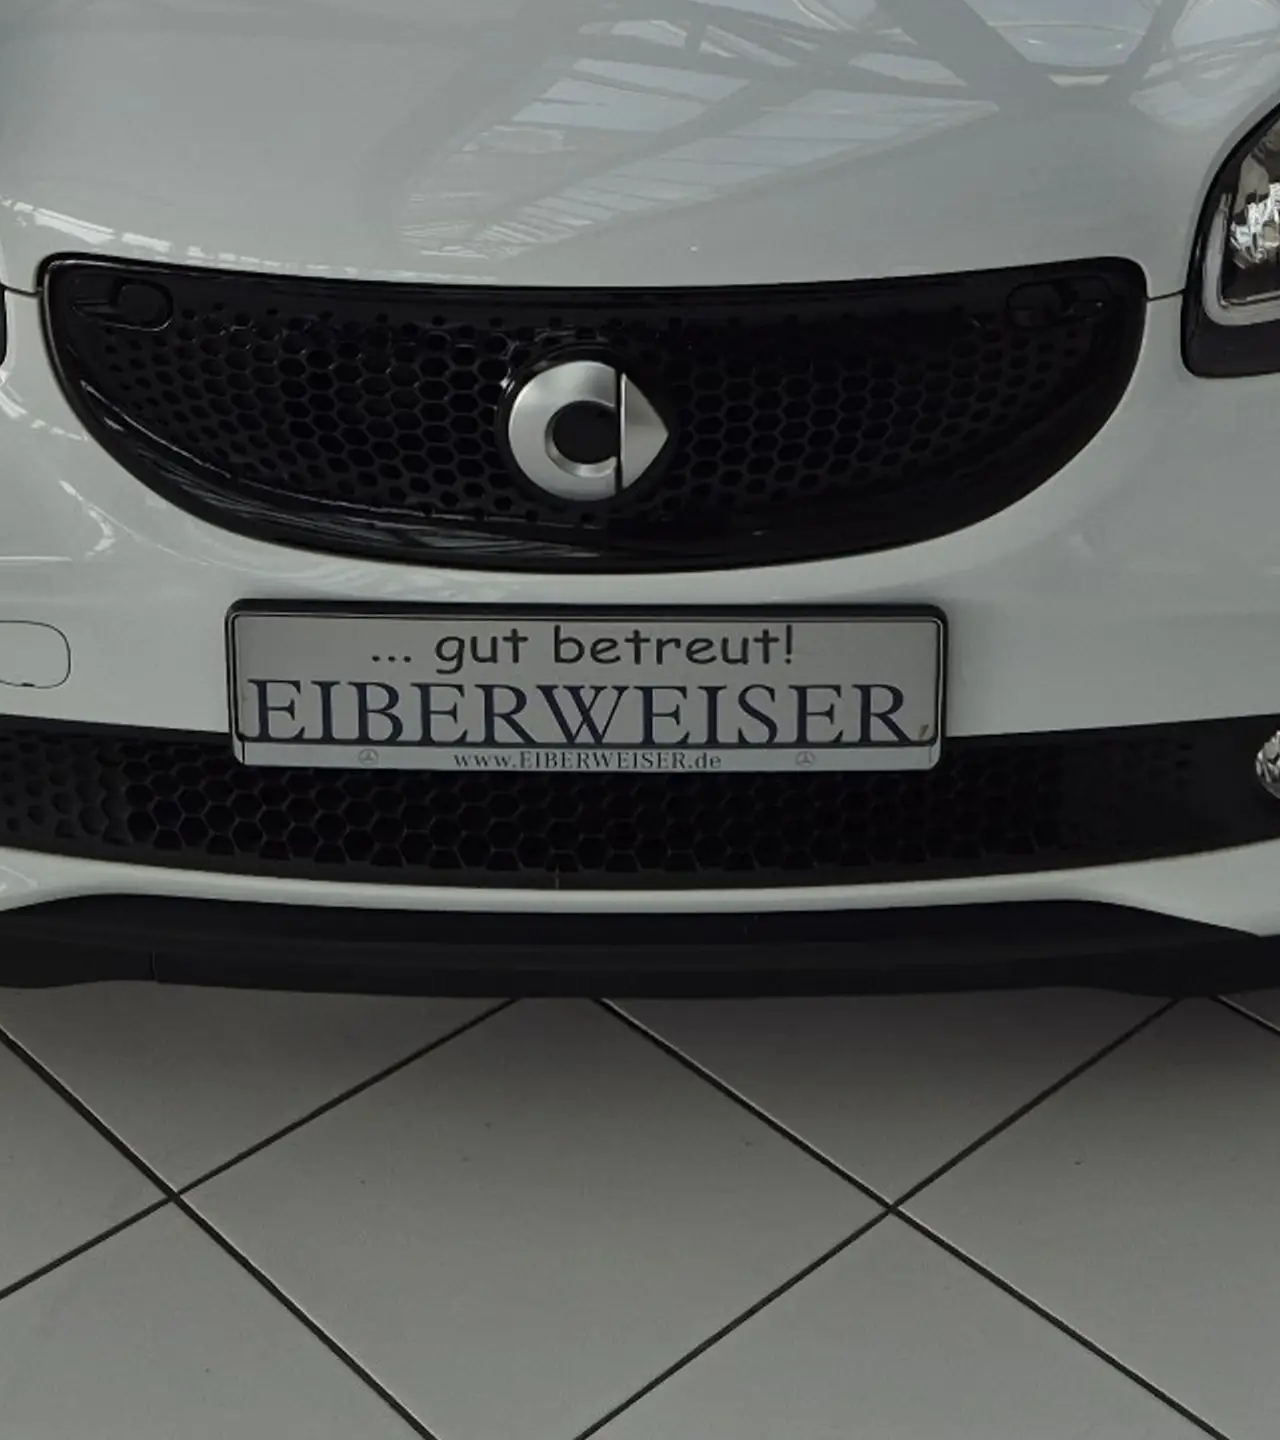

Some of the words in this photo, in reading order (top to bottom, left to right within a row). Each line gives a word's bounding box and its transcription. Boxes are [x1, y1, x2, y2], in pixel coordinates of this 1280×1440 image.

[434, 628, 529, 675] gut
[553, 624, 793, 665] betreut!
[246, 678, 915, 747] EIBERWEISER
[453, 750, 723, 770] www.EIBERWEISER.de
